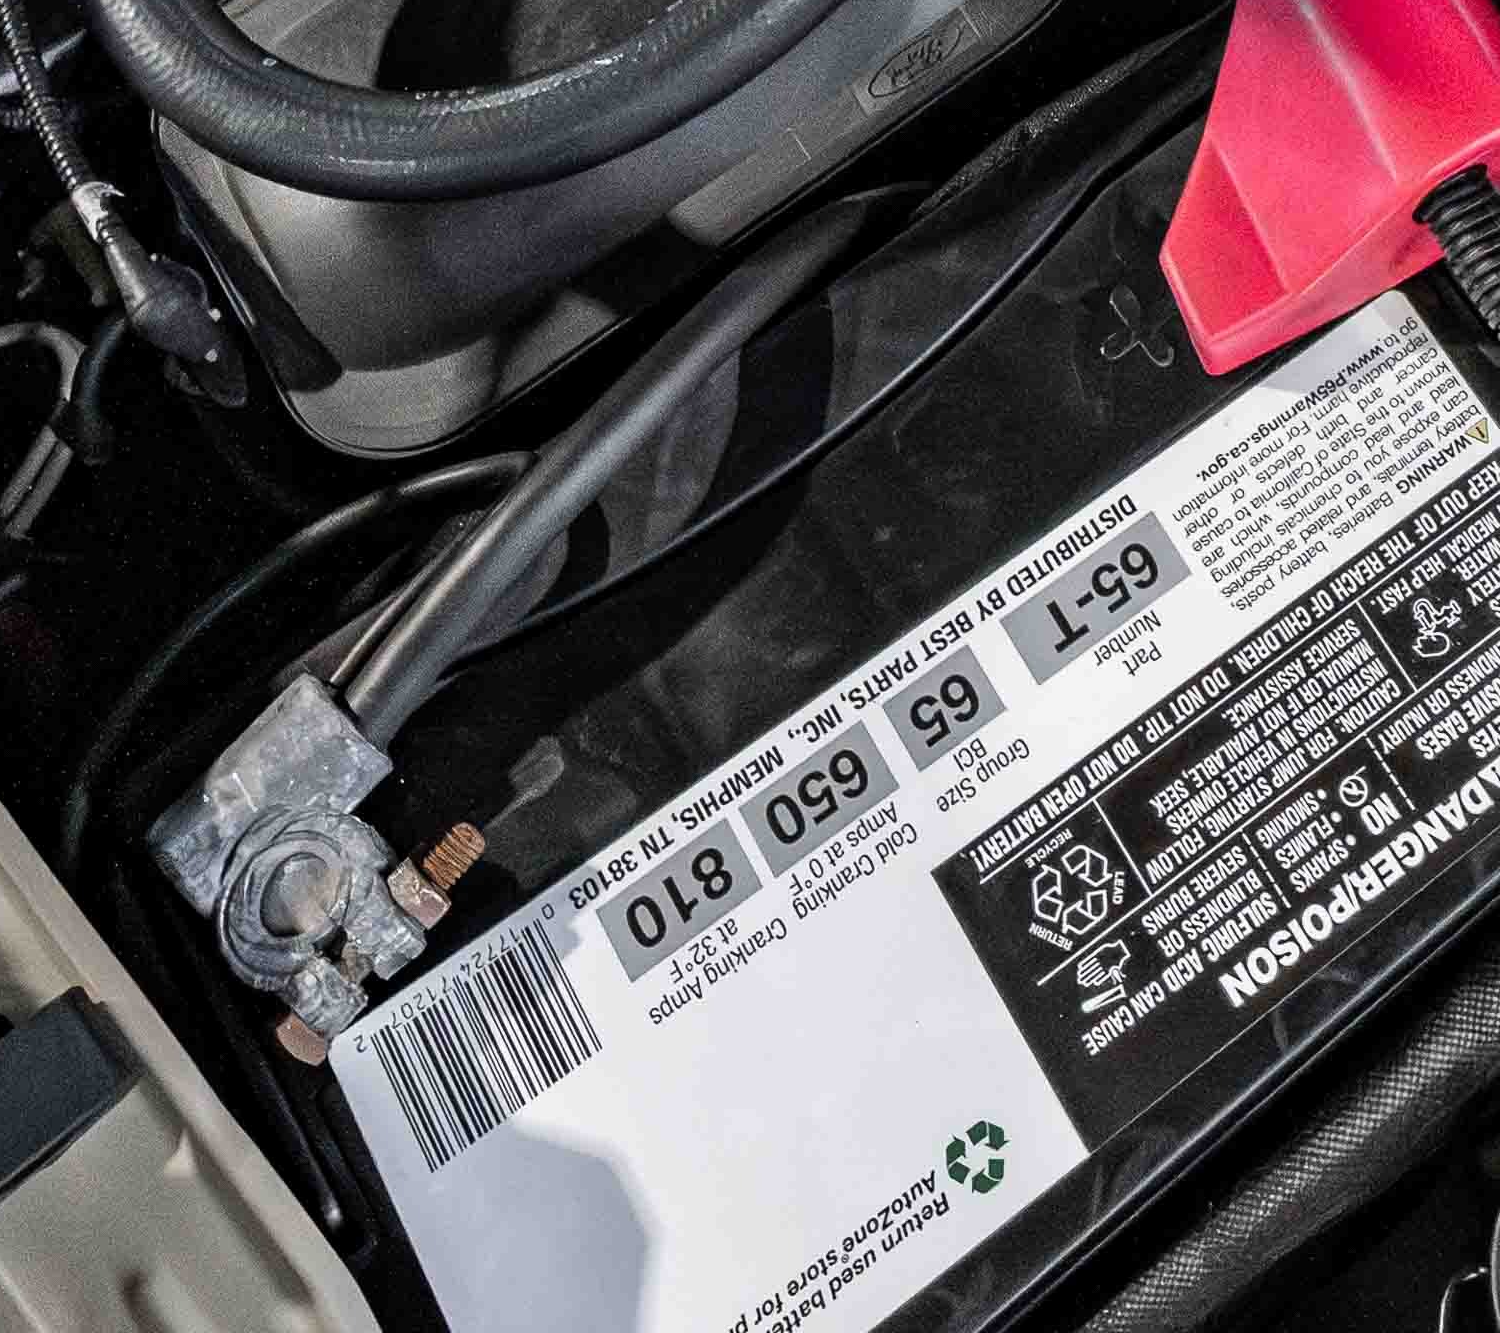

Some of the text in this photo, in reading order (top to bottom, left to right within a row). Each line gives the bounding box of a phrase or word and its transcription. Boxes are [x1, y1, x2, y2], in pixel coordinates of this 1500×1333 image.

[1196, 316, 1418, 481] go to www.P65Warnings.ca.gov.
[1230, 435, 1472, 611] WARNING Batteries, battery posts,
[1414, 512, 1438, 541] OF
[1433, 489, 1469, 525] OUT
[1378, 530, 1416, 564] THE
[1046, 543, 1158, 653] 65-T
[1329, 551, 1386, 601] REACH
[1310, 589, 1334, 618] OF
[1094, 610, 1161, 666] Number
[1122, 641, 1162, 676] Part
[1227, 606, 1312, 674] CHILDREN.
[568, 494, 1137, 910] DISTRIBUTED BY BEST PARTS, INC., MEMPHIS, TN 38103
[1169, 685, 1206, 724] NOT
[1201, 667, 1231, 697] DO
[1424, 688, 1451, 715] OR
[910, 674, 979, 748] 65
[1137, 711, 1174, 743] TIP.
[1378, 704, 1431, 754] INJURY
[1416, 710, 1469, 760] GASES
[953, 738, 987, 772] BCI
[1082, 750, 1118, 789] NOT
[1112, 734, 1141, 765] DO
[766, 749, 868, 844] 650
[936, 738, 1030, 812] Group Size
[1040, 775, 1086, 819] OPEN
[846, 801, 897, 847] Amps
[969, 804, 1047, 872] BATTERY!
[1256, 792, 1320, 849] SMOKING
[1360, 792, 1401, 835] NO
[823, 841, 845, 867] at
[1024, 828, 1073, 868] RECYCLE
[1275, 815, 1334, 869] FLAMES
[1289, 839, 1349, 893] SPARKS
[792, 823, 917, 920] Cold Cranking
[1112, 871, 1124, 904] LEAD
[1141, 845, 1247, 935] SEVERE BURNS
[1218, 776, 1494, 1008] DANGER/POISON
[626, 848, 732, 948] 810
[1157, 869, 1263, 957] BLINDNESS OR
[716, 918, 738, 945] at
[1028, 921, 1073, 949] RETURN
[353, 902, 556, 1053] 0 17724 71207 2
[649, 918, 787, 1025] Cranking Amps
[1082, 892, 1277, 1055] SULFURIC ACID CAN CAUSE
[881, 1192, 950, 1252] Return
[787, 1249, 838, 1296] store
[829, 1249, 876, 1300] used
[754, 1293, 783, 1325] for
